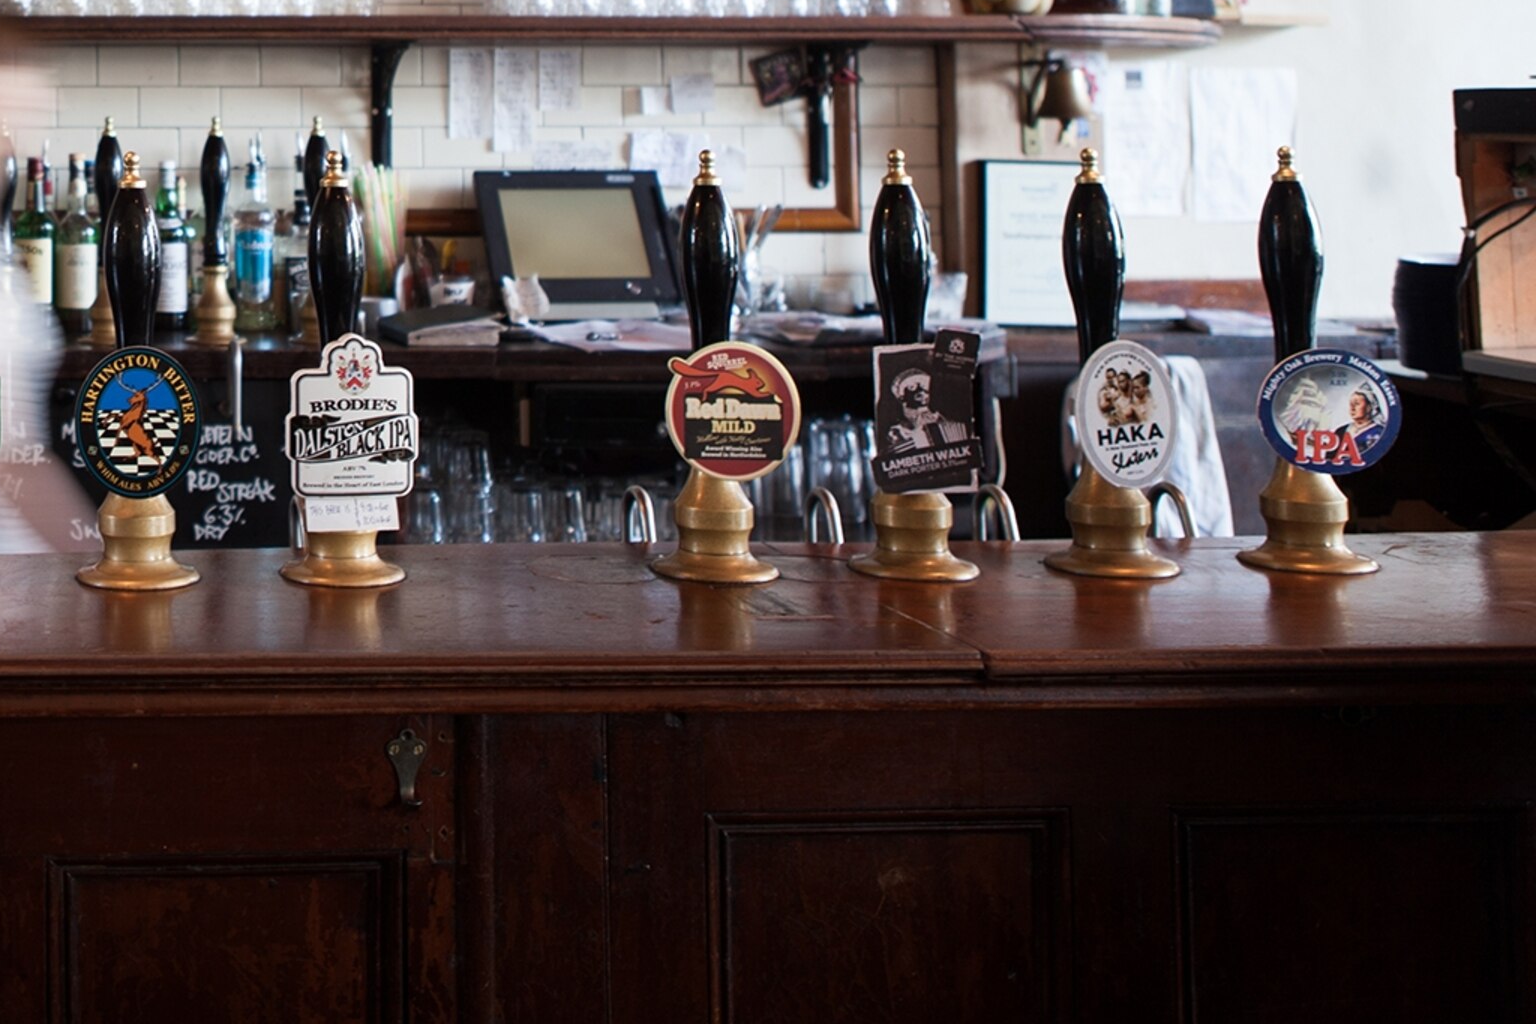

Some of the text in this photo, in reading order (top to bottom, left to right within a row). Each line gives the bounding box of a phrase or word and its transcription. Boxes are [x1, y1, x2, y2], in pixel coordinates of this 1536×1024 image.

[712, 353, 729, 362] RED
[81, 354, 196, 424] HARTINGTON BITTER
[1263, 353, 1397, 406] Mighty Oak Brewery Maldon Essex
[310, 398, 398, 413] BRODIE'S
[685, 397, 782, 420] Red Dawn
[336, 418, 413, 458] BLACK IPA
[711, 420, 756, 434] MILD
[1097, 423, 1163, 446] HAKA
[294, 422, 364, 458] DALSTON
[725, 445, 749, 453] Winning
[1295, 430, 1365, 466] IPA
[195, 447, 240, 465] CIDER
[882, 446, 973, 472] LAMBETH WALK
[1112, 447, 1159, 474] Slaters
[888, 462, 942, 479] DARK PORTER
[119, 479, 142, 491] ALES
[187, 470, 276, 503] RED STREAK
[194, 524, 230, 541] DRY
